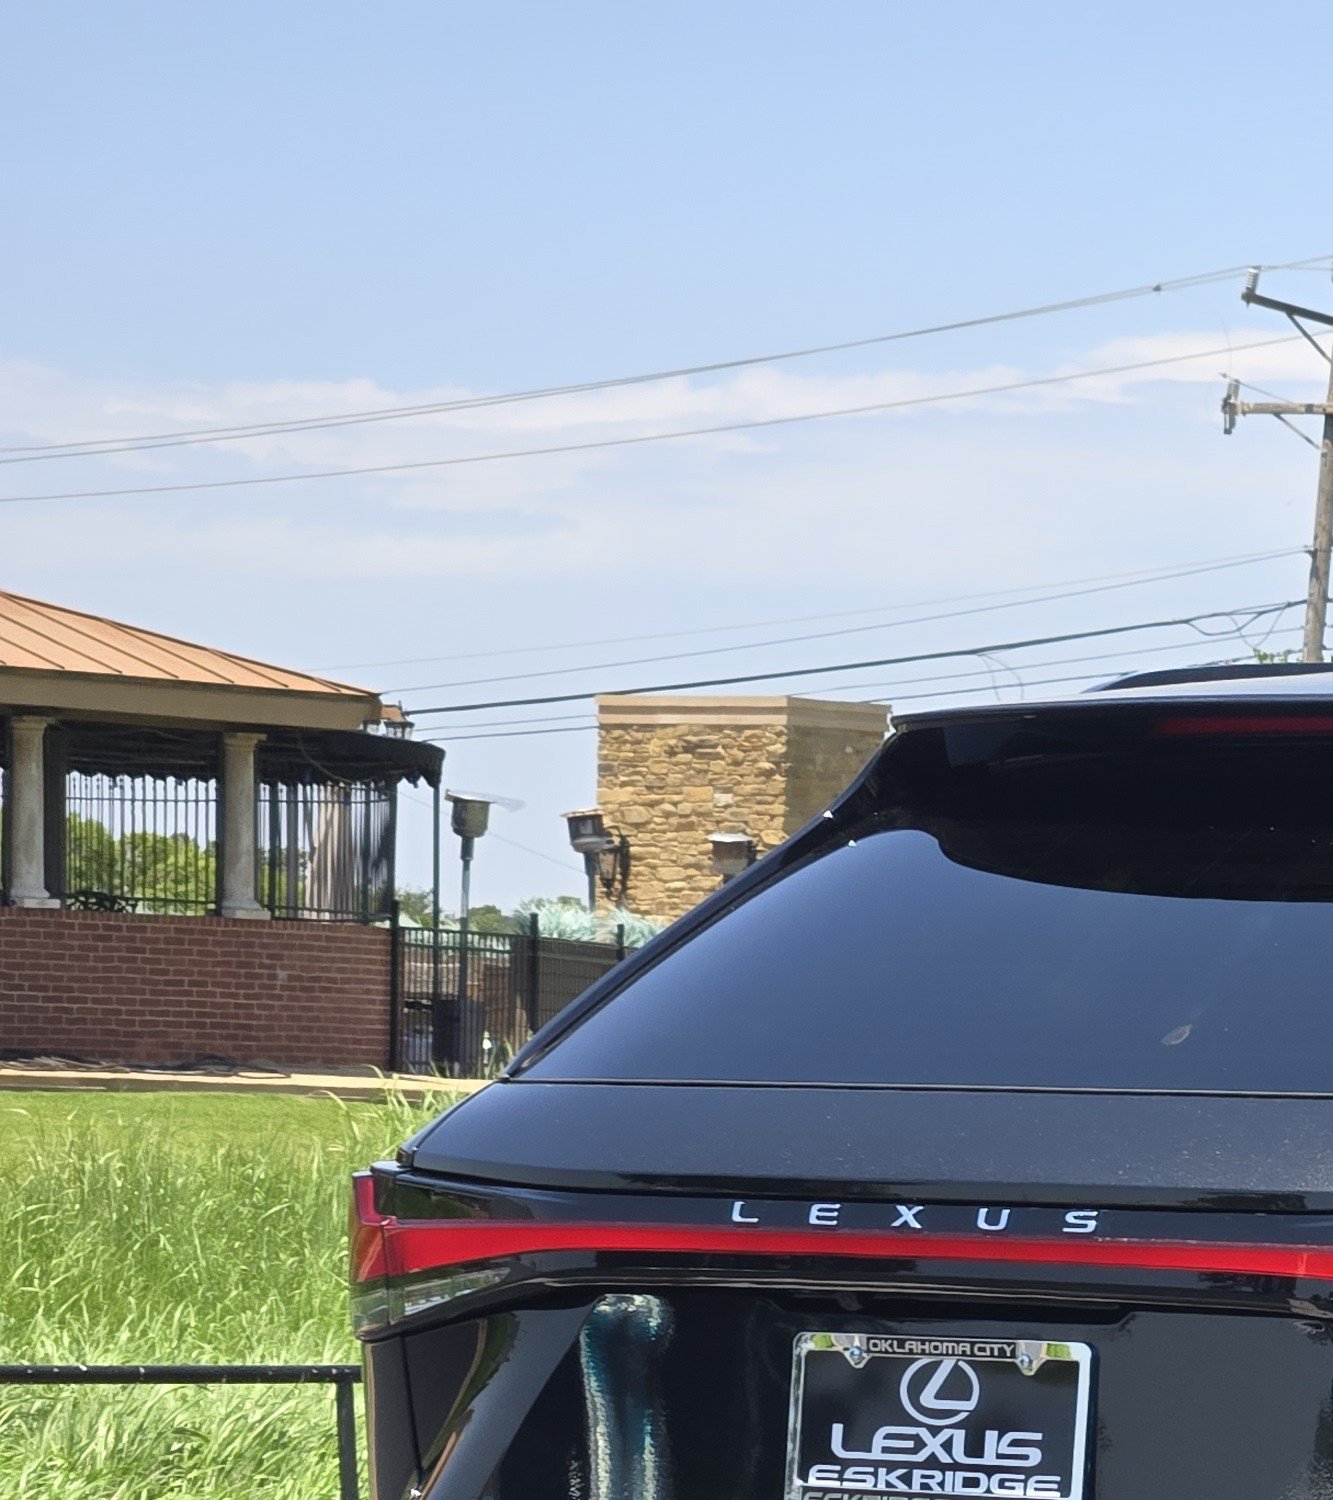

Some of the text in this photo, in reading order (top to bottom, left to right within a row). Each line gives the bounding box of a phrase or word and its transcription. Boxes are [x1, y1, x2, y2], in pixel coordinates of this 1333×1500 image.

[731, 1200, 1099, 1234] LEXUS
[868, 1338, 1015, 1358] OKLAHOMA CITY
[830, 1422, 1043, 1467] LEXUS
[808, 1464, 1061, 1498] ESKRIDGE
